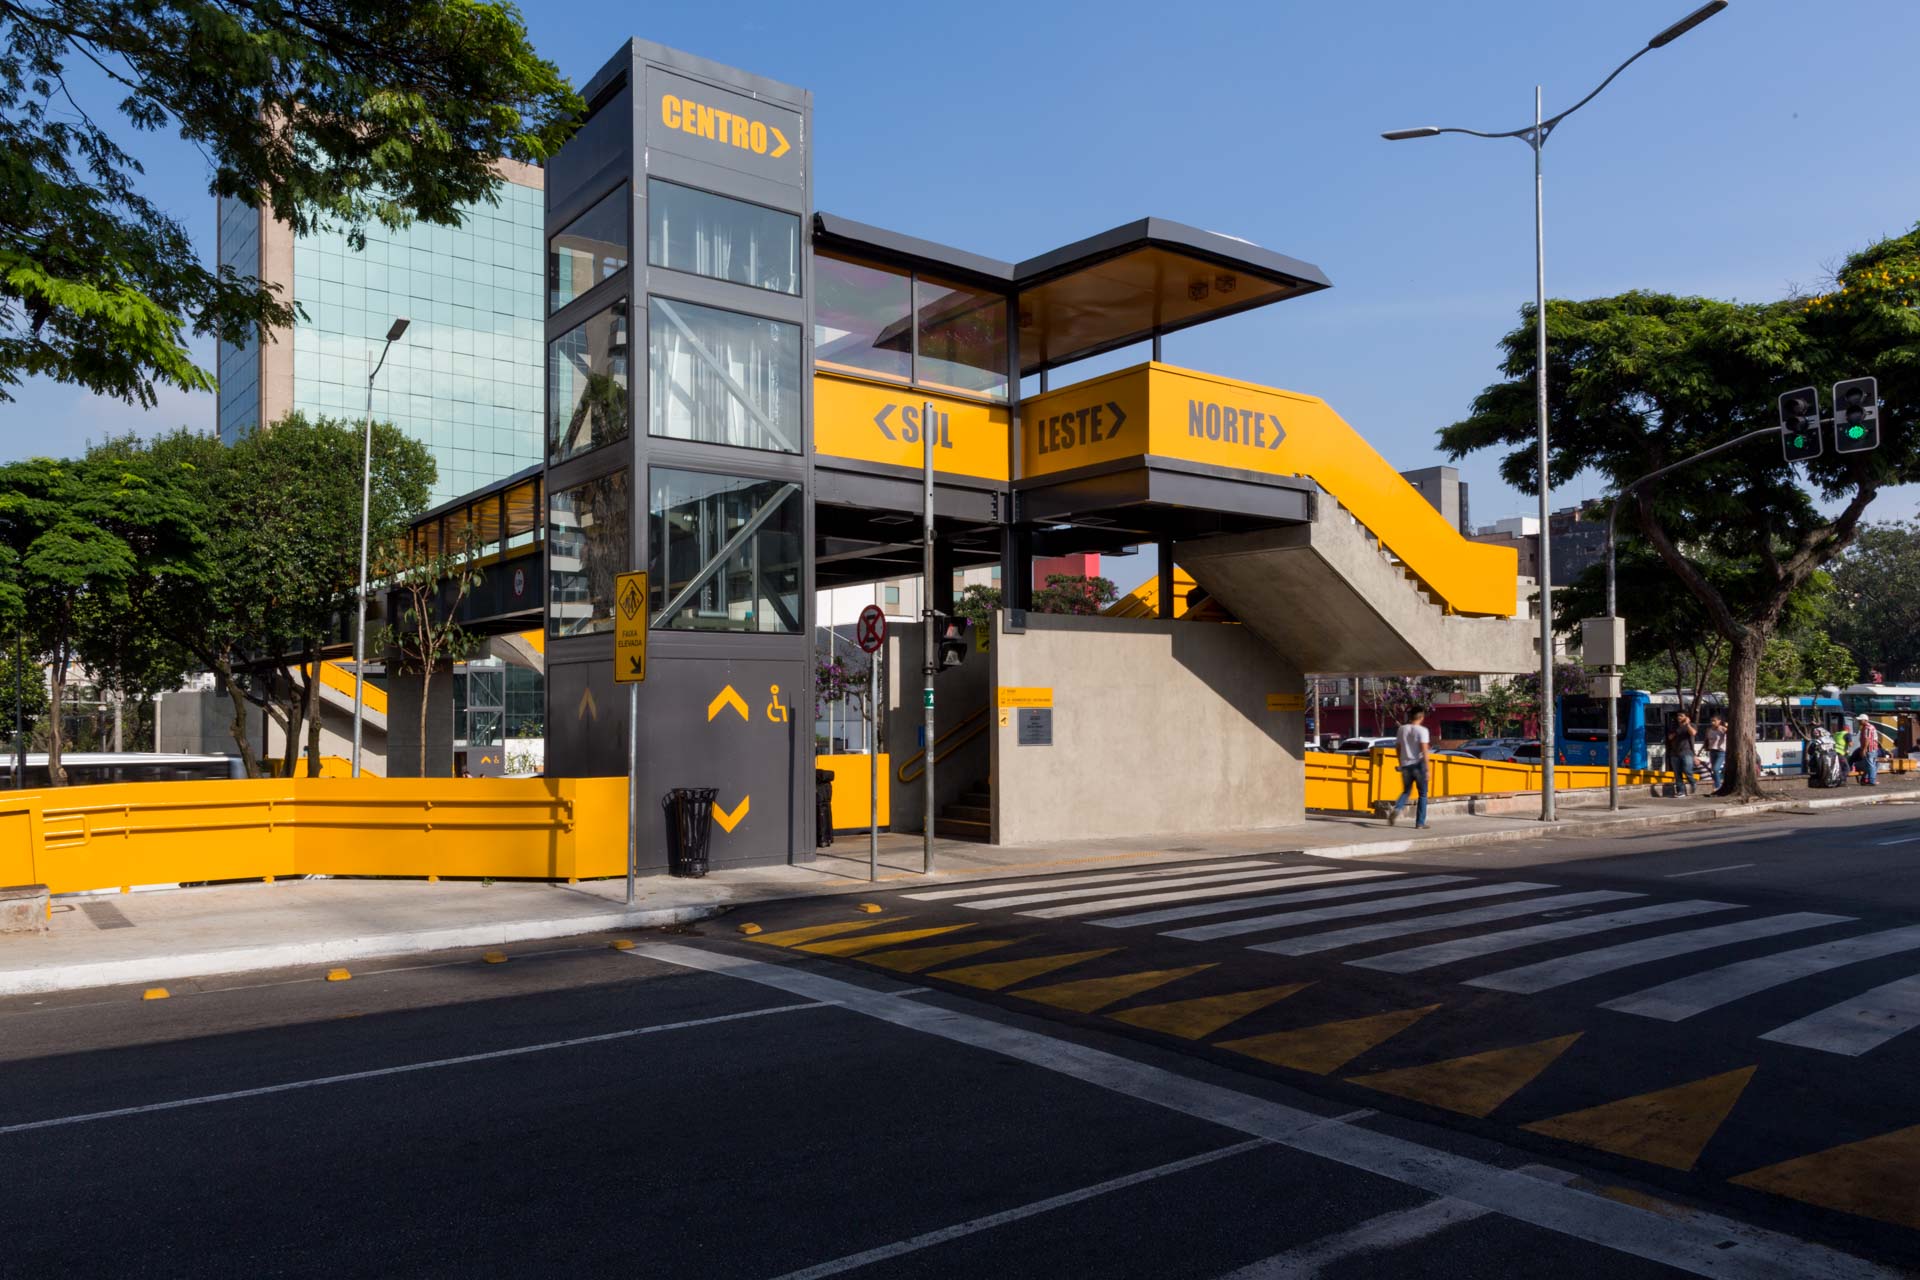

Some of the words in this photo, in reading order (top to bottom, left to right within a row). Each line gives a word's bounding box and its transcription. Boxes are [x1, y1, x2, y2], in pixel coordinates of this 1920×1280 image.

[661, 94, 768, 155] CENTRO
[1038, 404, 1104, 455] LESTE
[1188, 399, 1265, 448] NORTE
[618, 639, 642, 648] ELEVADA
[622, 630, 638, 638] FAIXA
